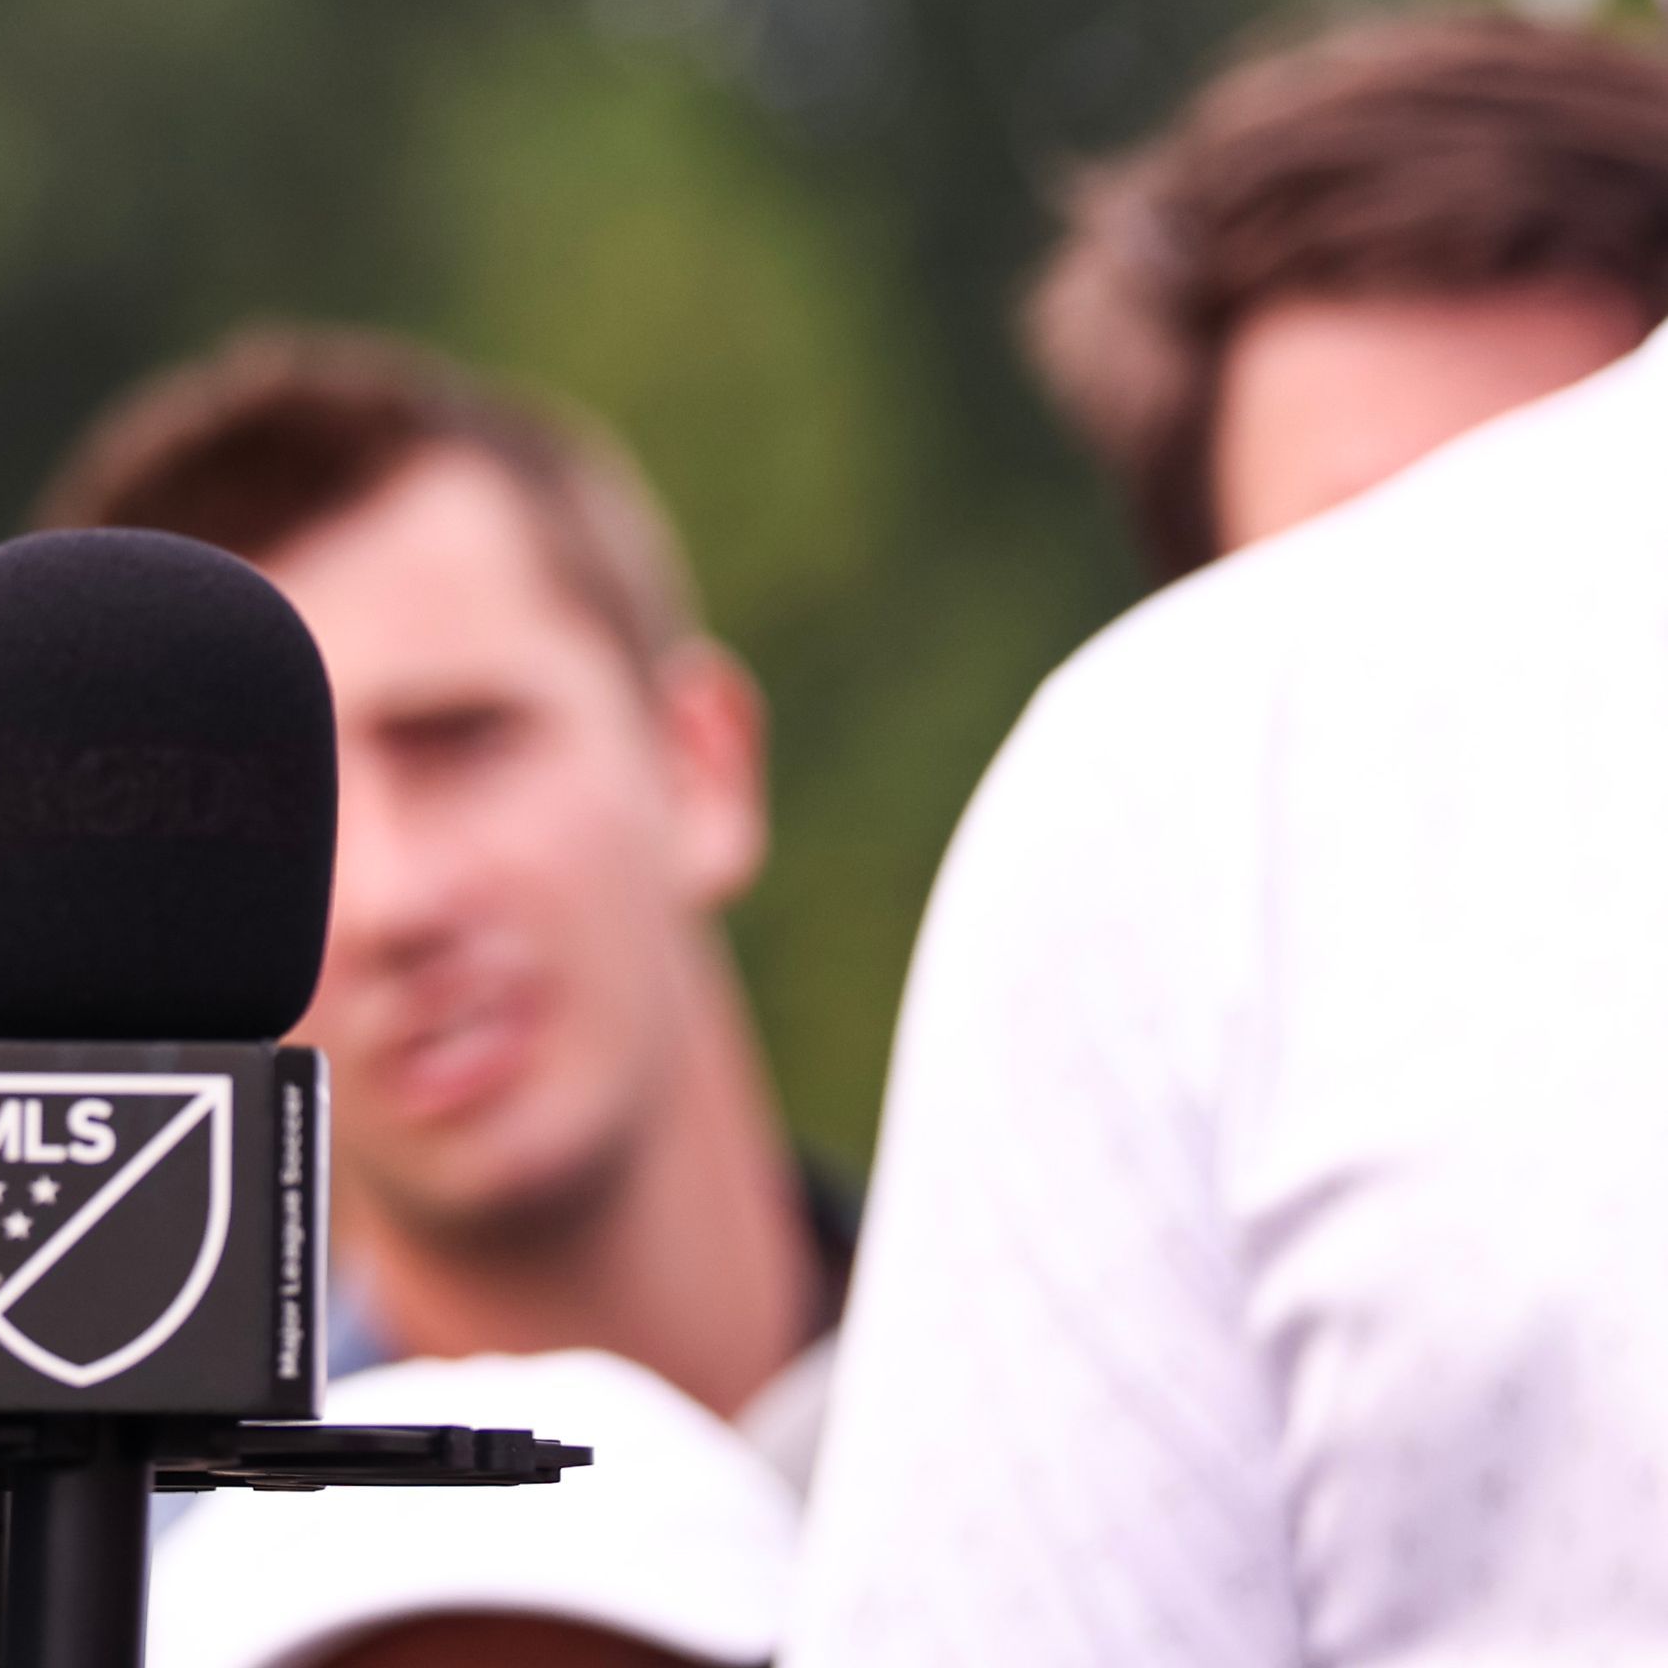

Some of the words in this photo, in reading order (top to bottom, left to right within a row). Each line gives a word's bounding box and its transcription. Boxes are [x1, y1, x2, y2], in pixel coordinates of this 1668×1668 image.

[280, 1082, 305, 1187] Soccer
[278, 1190, 305, 1297] League
[277, 1300, 304, 1379] Major
